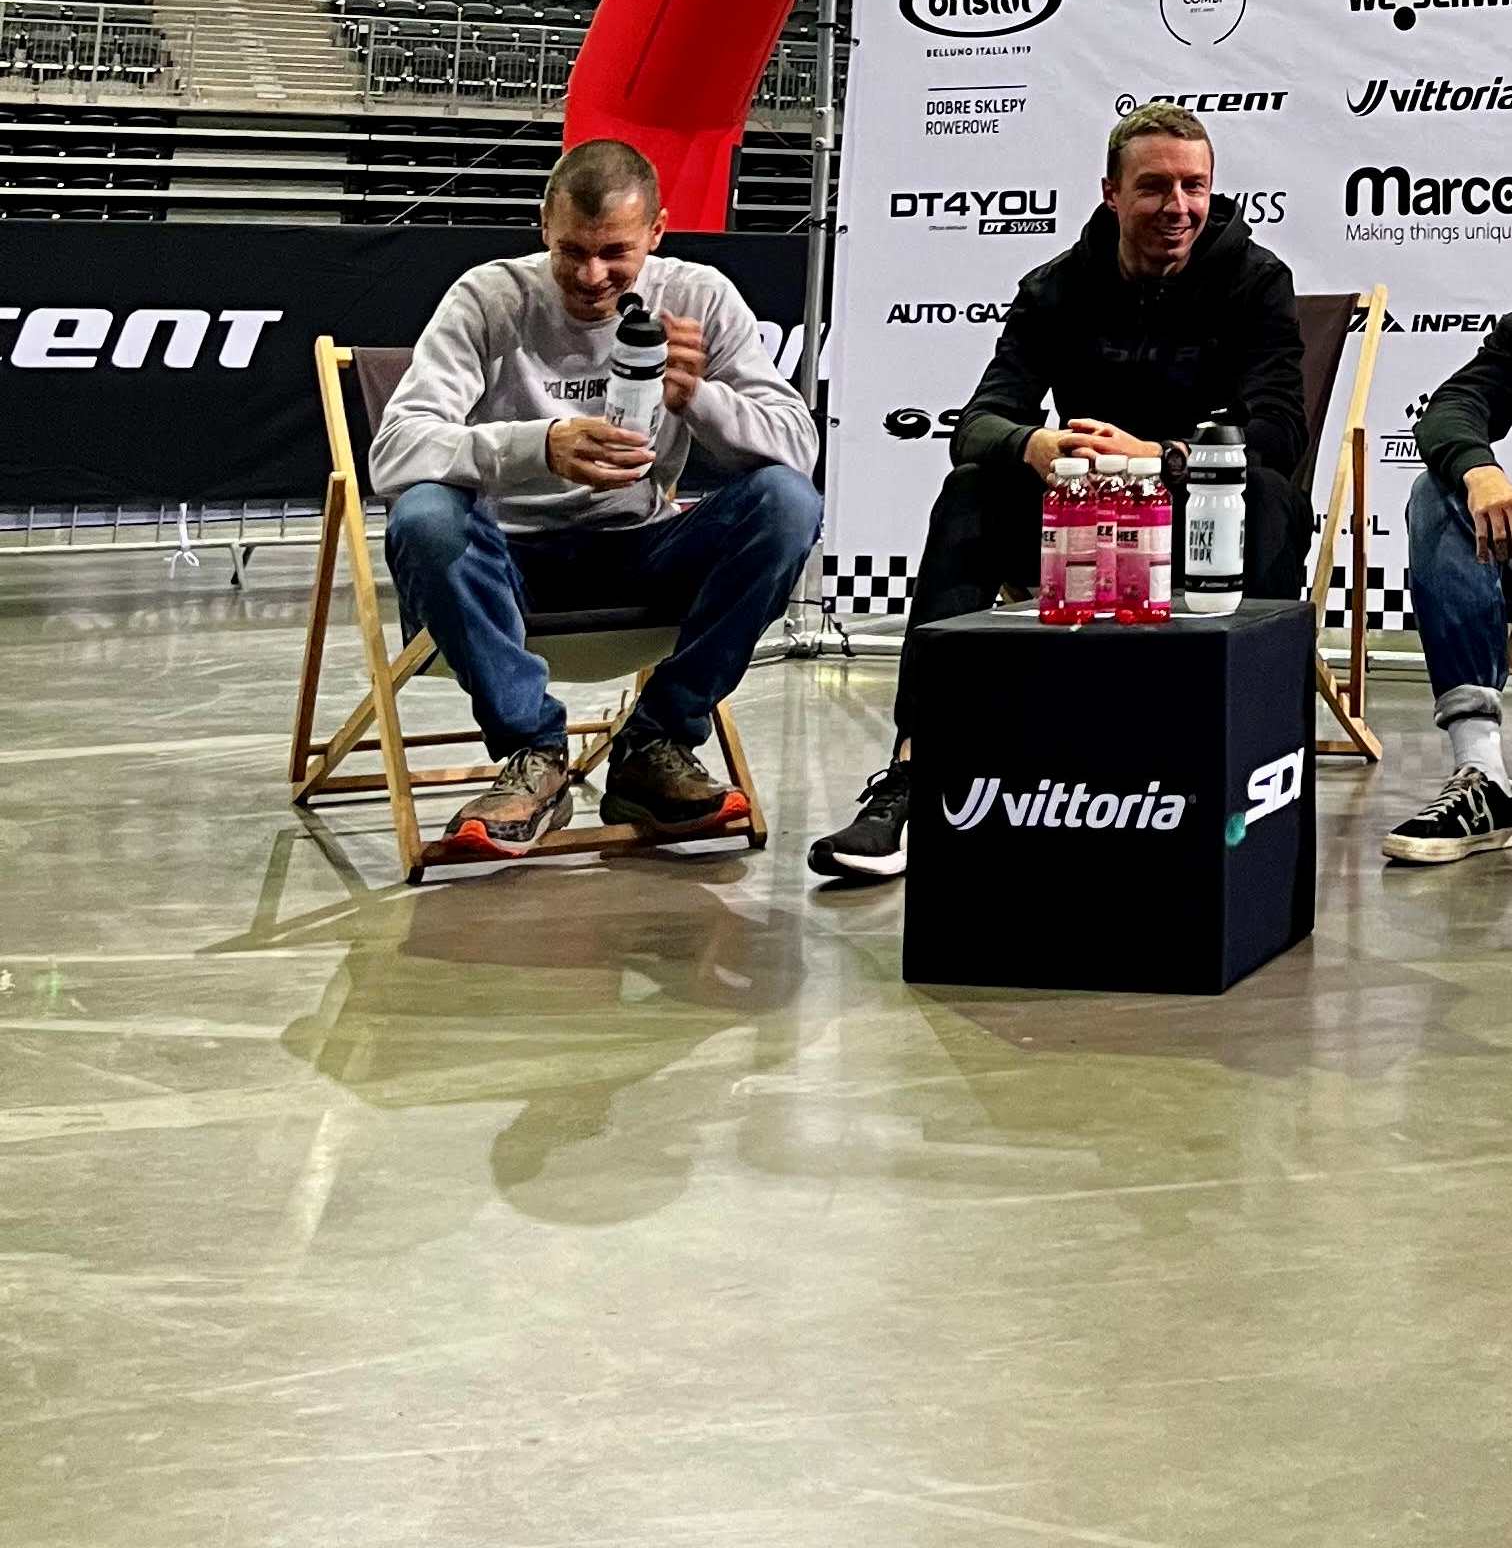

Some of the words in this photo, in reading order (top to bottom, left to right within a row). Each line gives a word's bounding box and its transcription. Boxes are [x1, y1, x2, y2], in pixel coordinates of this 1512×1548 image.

[927, 48, 972, 57] BELLUNO
[976, 47, 1008, 55] ITALIA
[927, 100, 971, 115] DOBRE
[975, 99, 1026, 113] SKLEPY
[926, 119, 999, 135] ROWEROWE
[890, 190, 1058, 217] DT4YOU
[1235, 191, 1287, 224] ISS
[983, 222, 1006, 232] DT
[1010, 221, 1049, 232] SWISS
[1346, 223, 1404, 245] Making
[1410, 223, 1459, 244] things
[886, 302, 1014, 324] AUTO-GAZ
[1411, 314, 1497, 332] INPEA
[1003, 779, 1185, 829] vittoria
